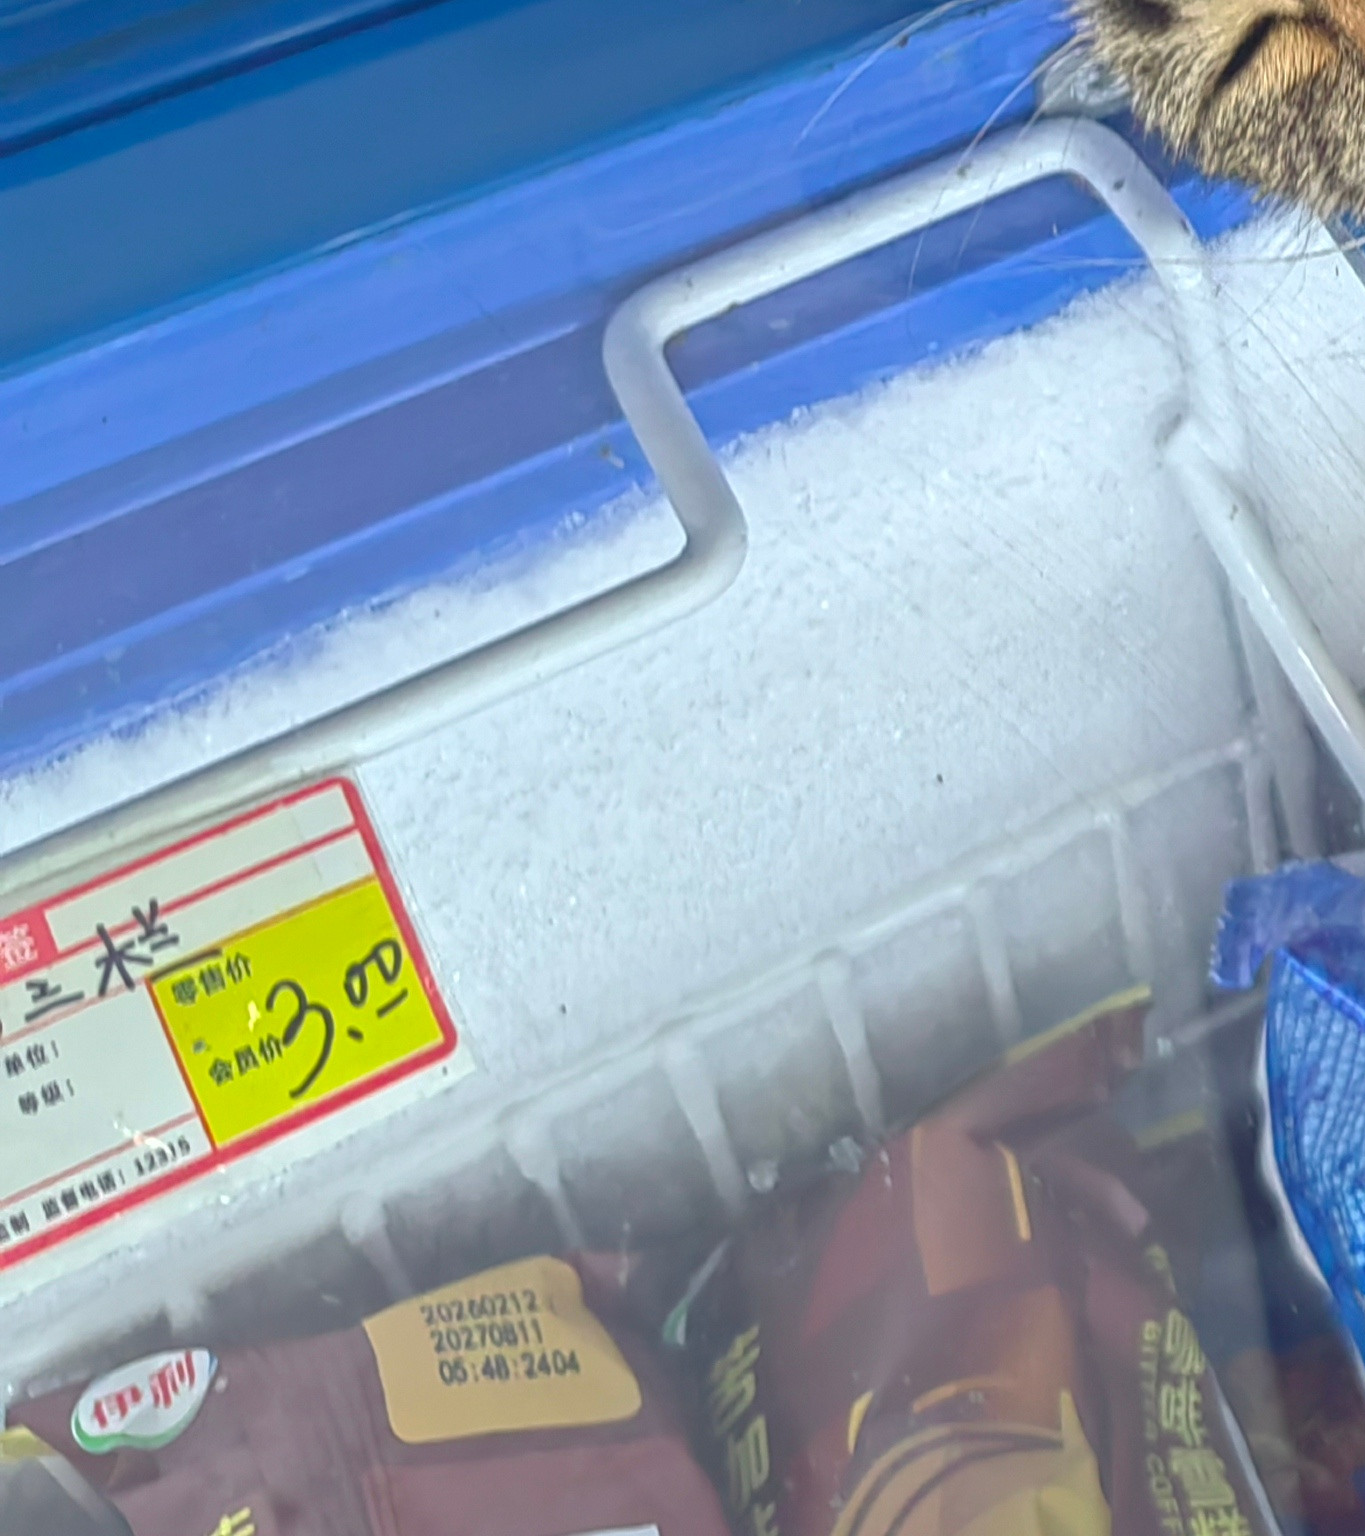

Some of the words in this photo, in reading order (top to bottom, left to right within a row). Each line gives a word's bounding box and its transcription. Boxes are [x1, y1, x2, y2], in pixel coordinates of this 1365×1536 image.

[171, 952, 251, 1007] 零售价
[265, 937, 403, 1099] 3.00
[208, 1033, 283, 1087] 会员价
[93, 1349, 196, 1430] 伊利
